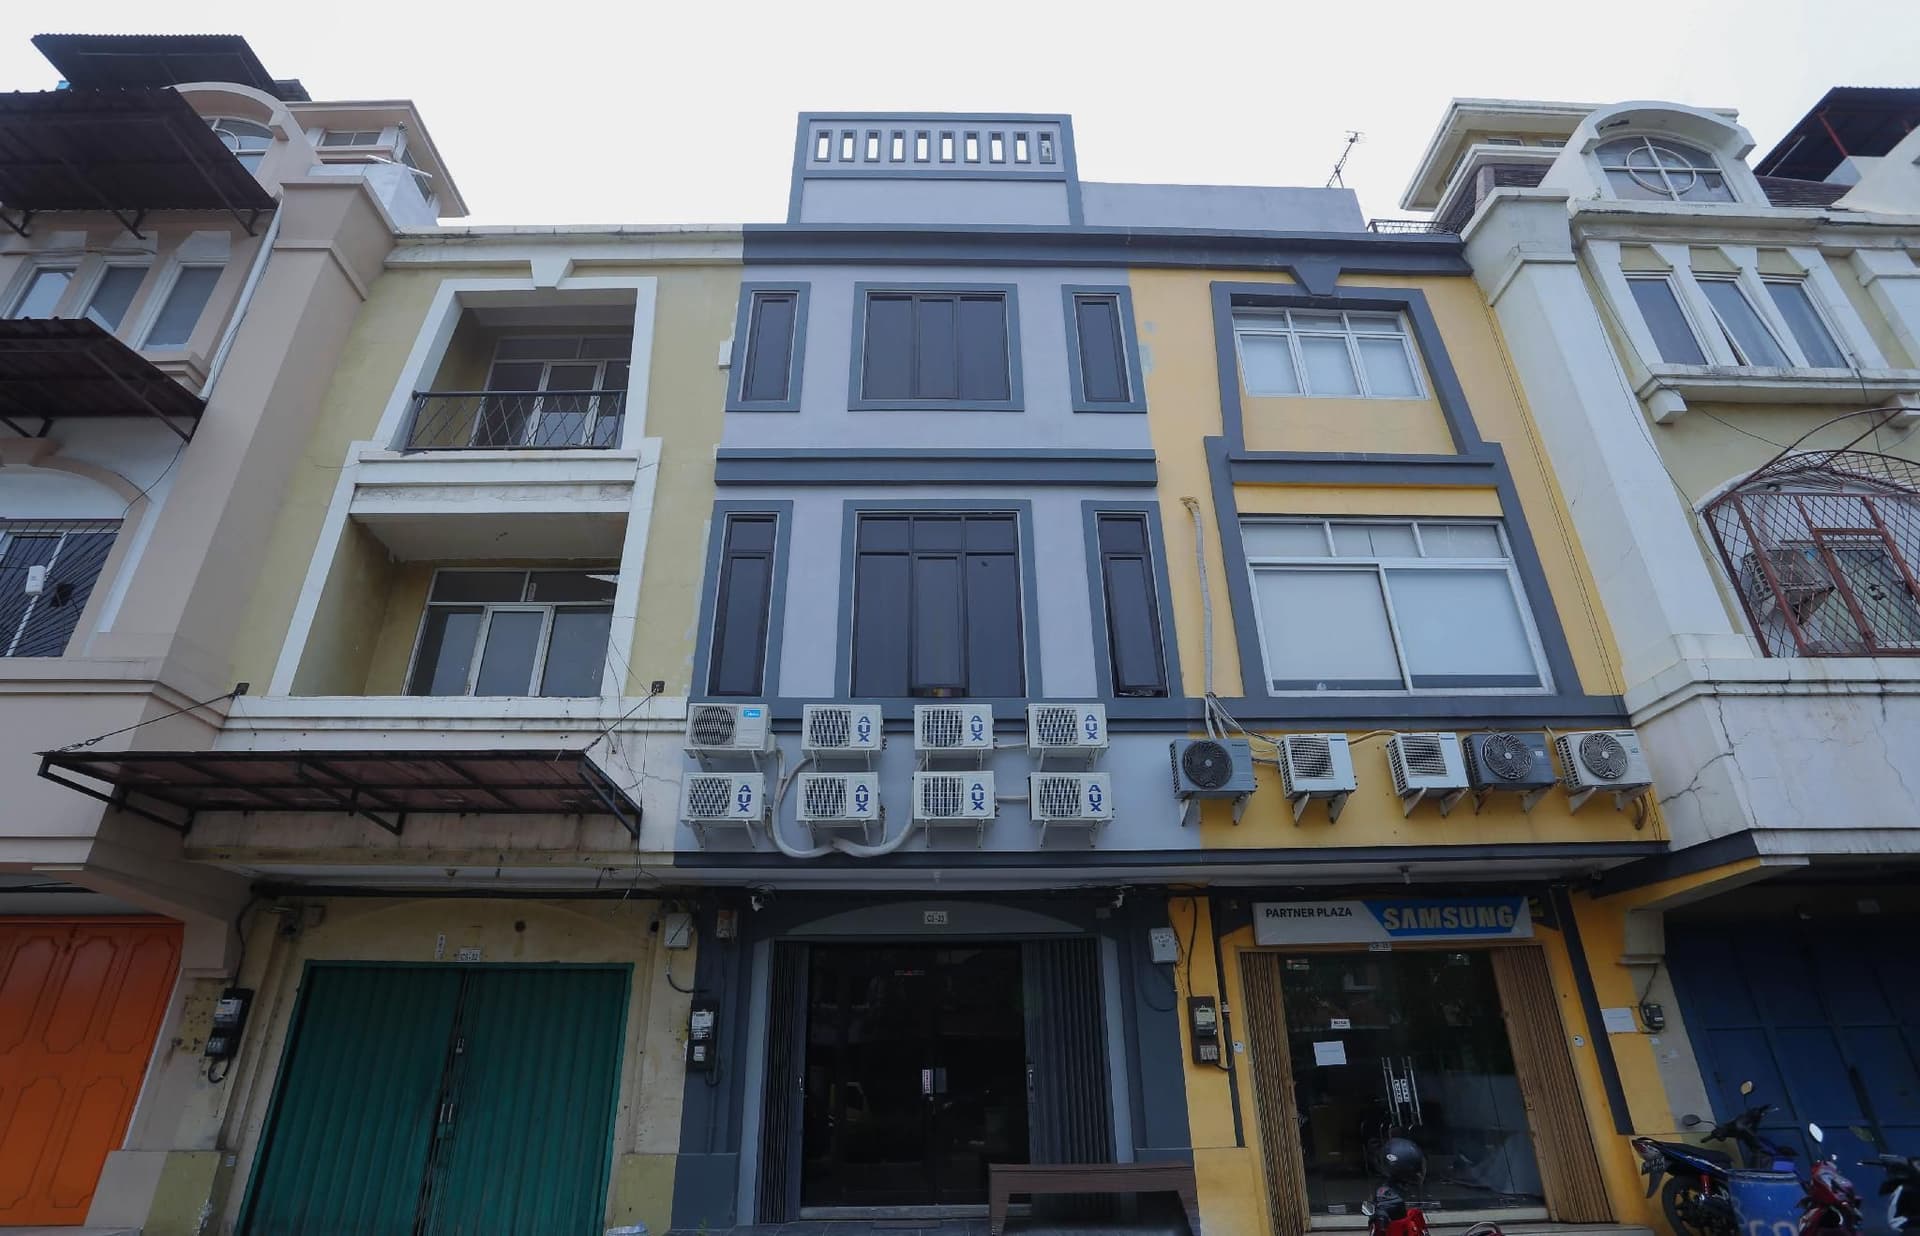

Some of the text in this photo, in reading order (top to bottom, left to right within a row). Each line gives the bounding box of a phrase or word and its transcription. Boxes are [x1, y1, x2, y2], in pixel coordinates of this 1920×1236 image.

[857, 715, 871, 742] AUX
[970, 714, 984, 742] AUX
[1084, 713, 1098, 741] AUX
[737, 783, 752, 813] AUX
[855, 783, 869, 813] AUX
[970, 781, 985, 811] AUX
[1087, 782, 1103, 812] AUX
[1265, 906, 1353, 918] PARTNER PLAZA
[1382, 905, 1515, 930] SAMSUNG
